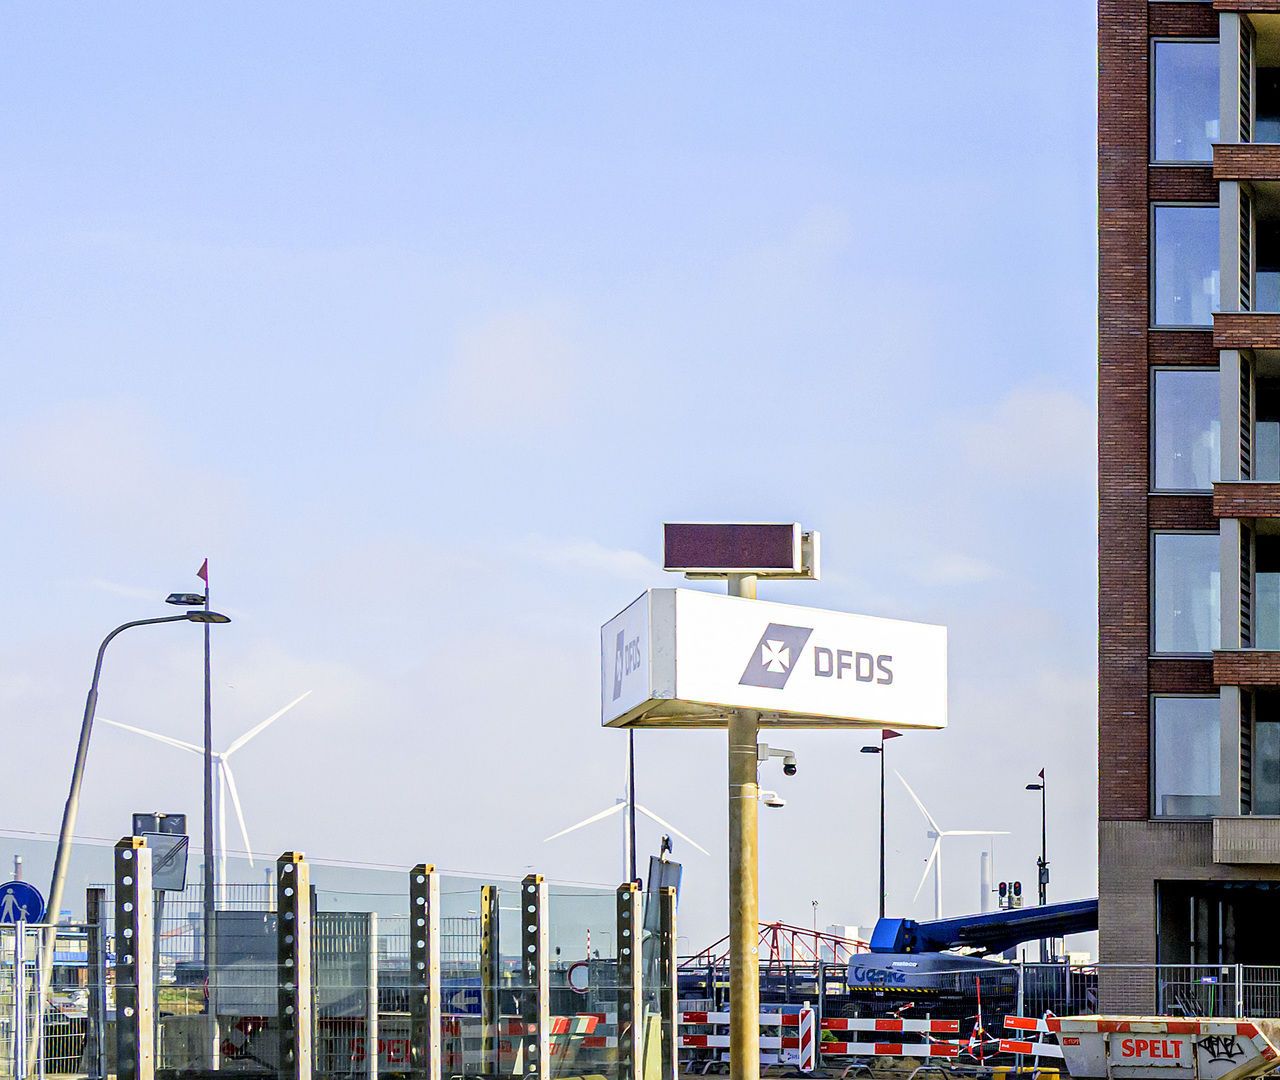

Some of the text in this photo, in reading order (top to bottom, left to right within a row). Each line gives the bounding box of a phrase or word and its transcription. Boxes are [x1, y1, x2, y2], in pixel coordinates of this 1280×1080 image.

[625, 636, 641, 676] DFDS
[814, 646, 893, 686] DFDS
[1121, 1039, 1183, 1058] SPELT
